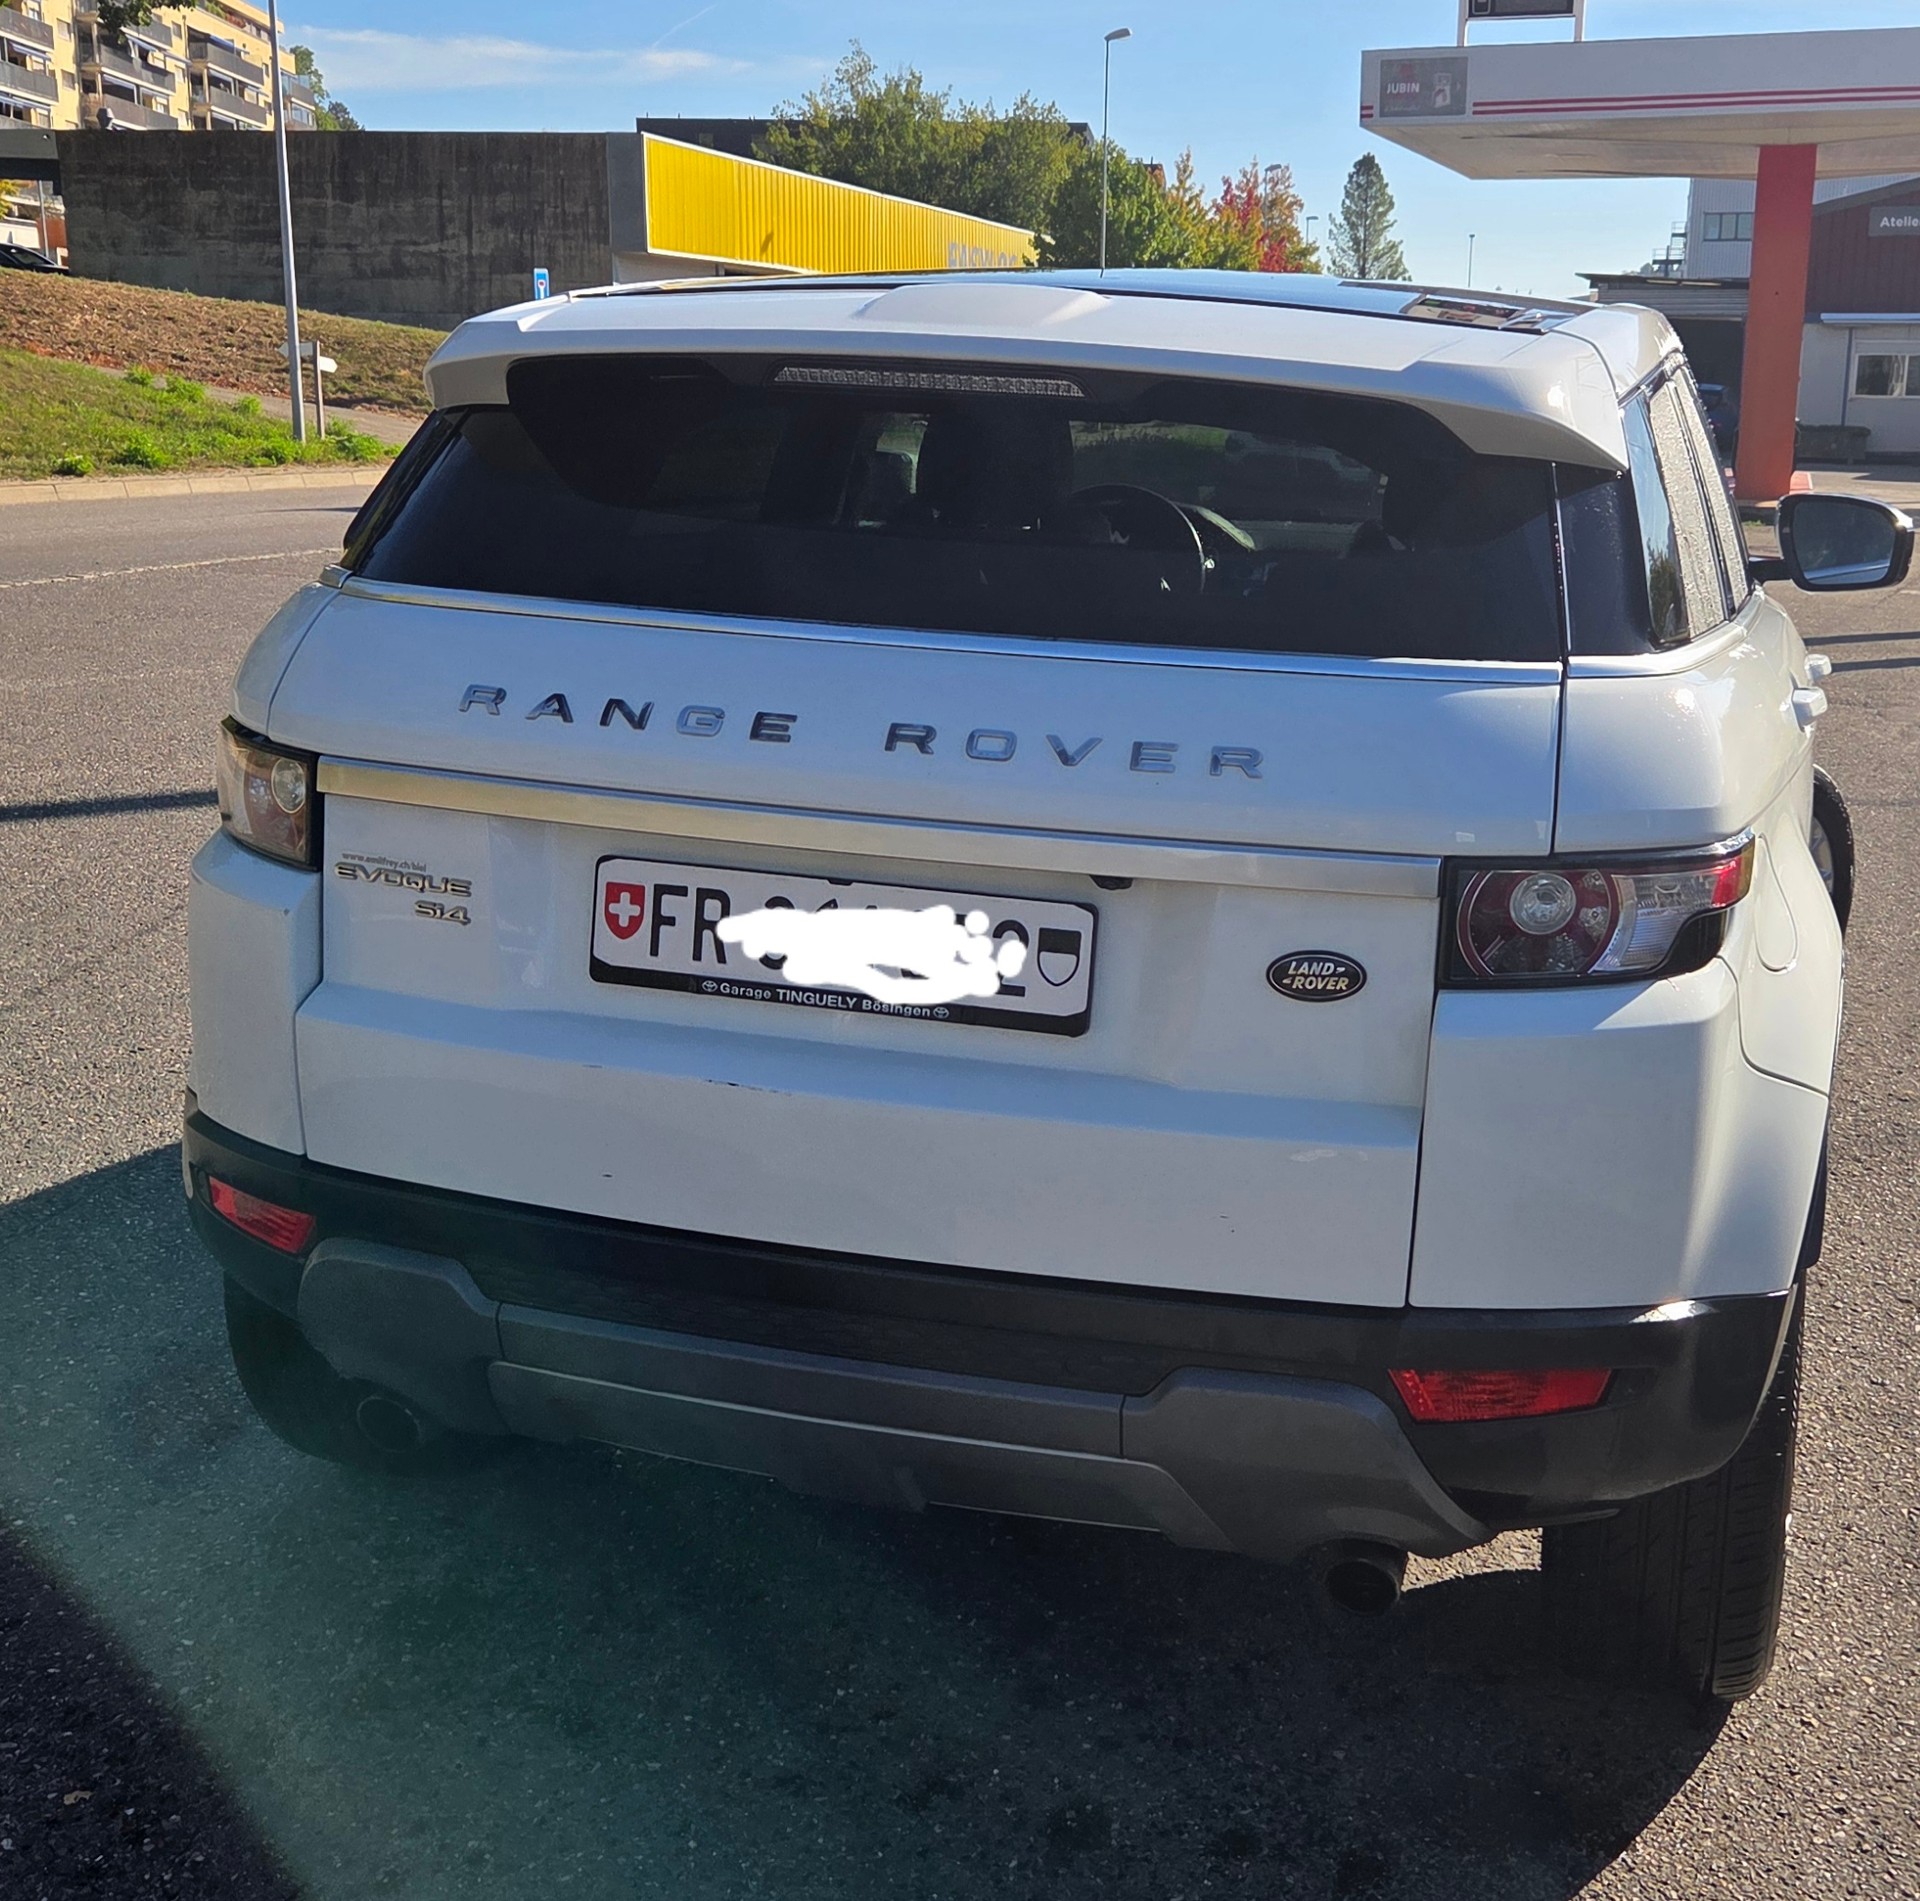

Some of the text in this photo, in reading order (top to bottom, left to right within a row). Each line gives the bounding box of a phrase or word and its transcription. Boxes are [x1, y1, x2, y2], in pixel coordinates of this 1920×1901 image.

[1386, 82, 1420, 94] JUBIN
[1879, 216, 1920, 227] Atelie
[458, 683, 1263, 779] RANGE ROVER
[334, 861, 472, 897] EVOQUE
[649, 883, 731, 965] FR
[1288, 961, 1335, 975] LAND
[1292, 976, 1349, 990] ROVER
[719, 982, 931, 1017] Garage TINGUELY Bösingen
